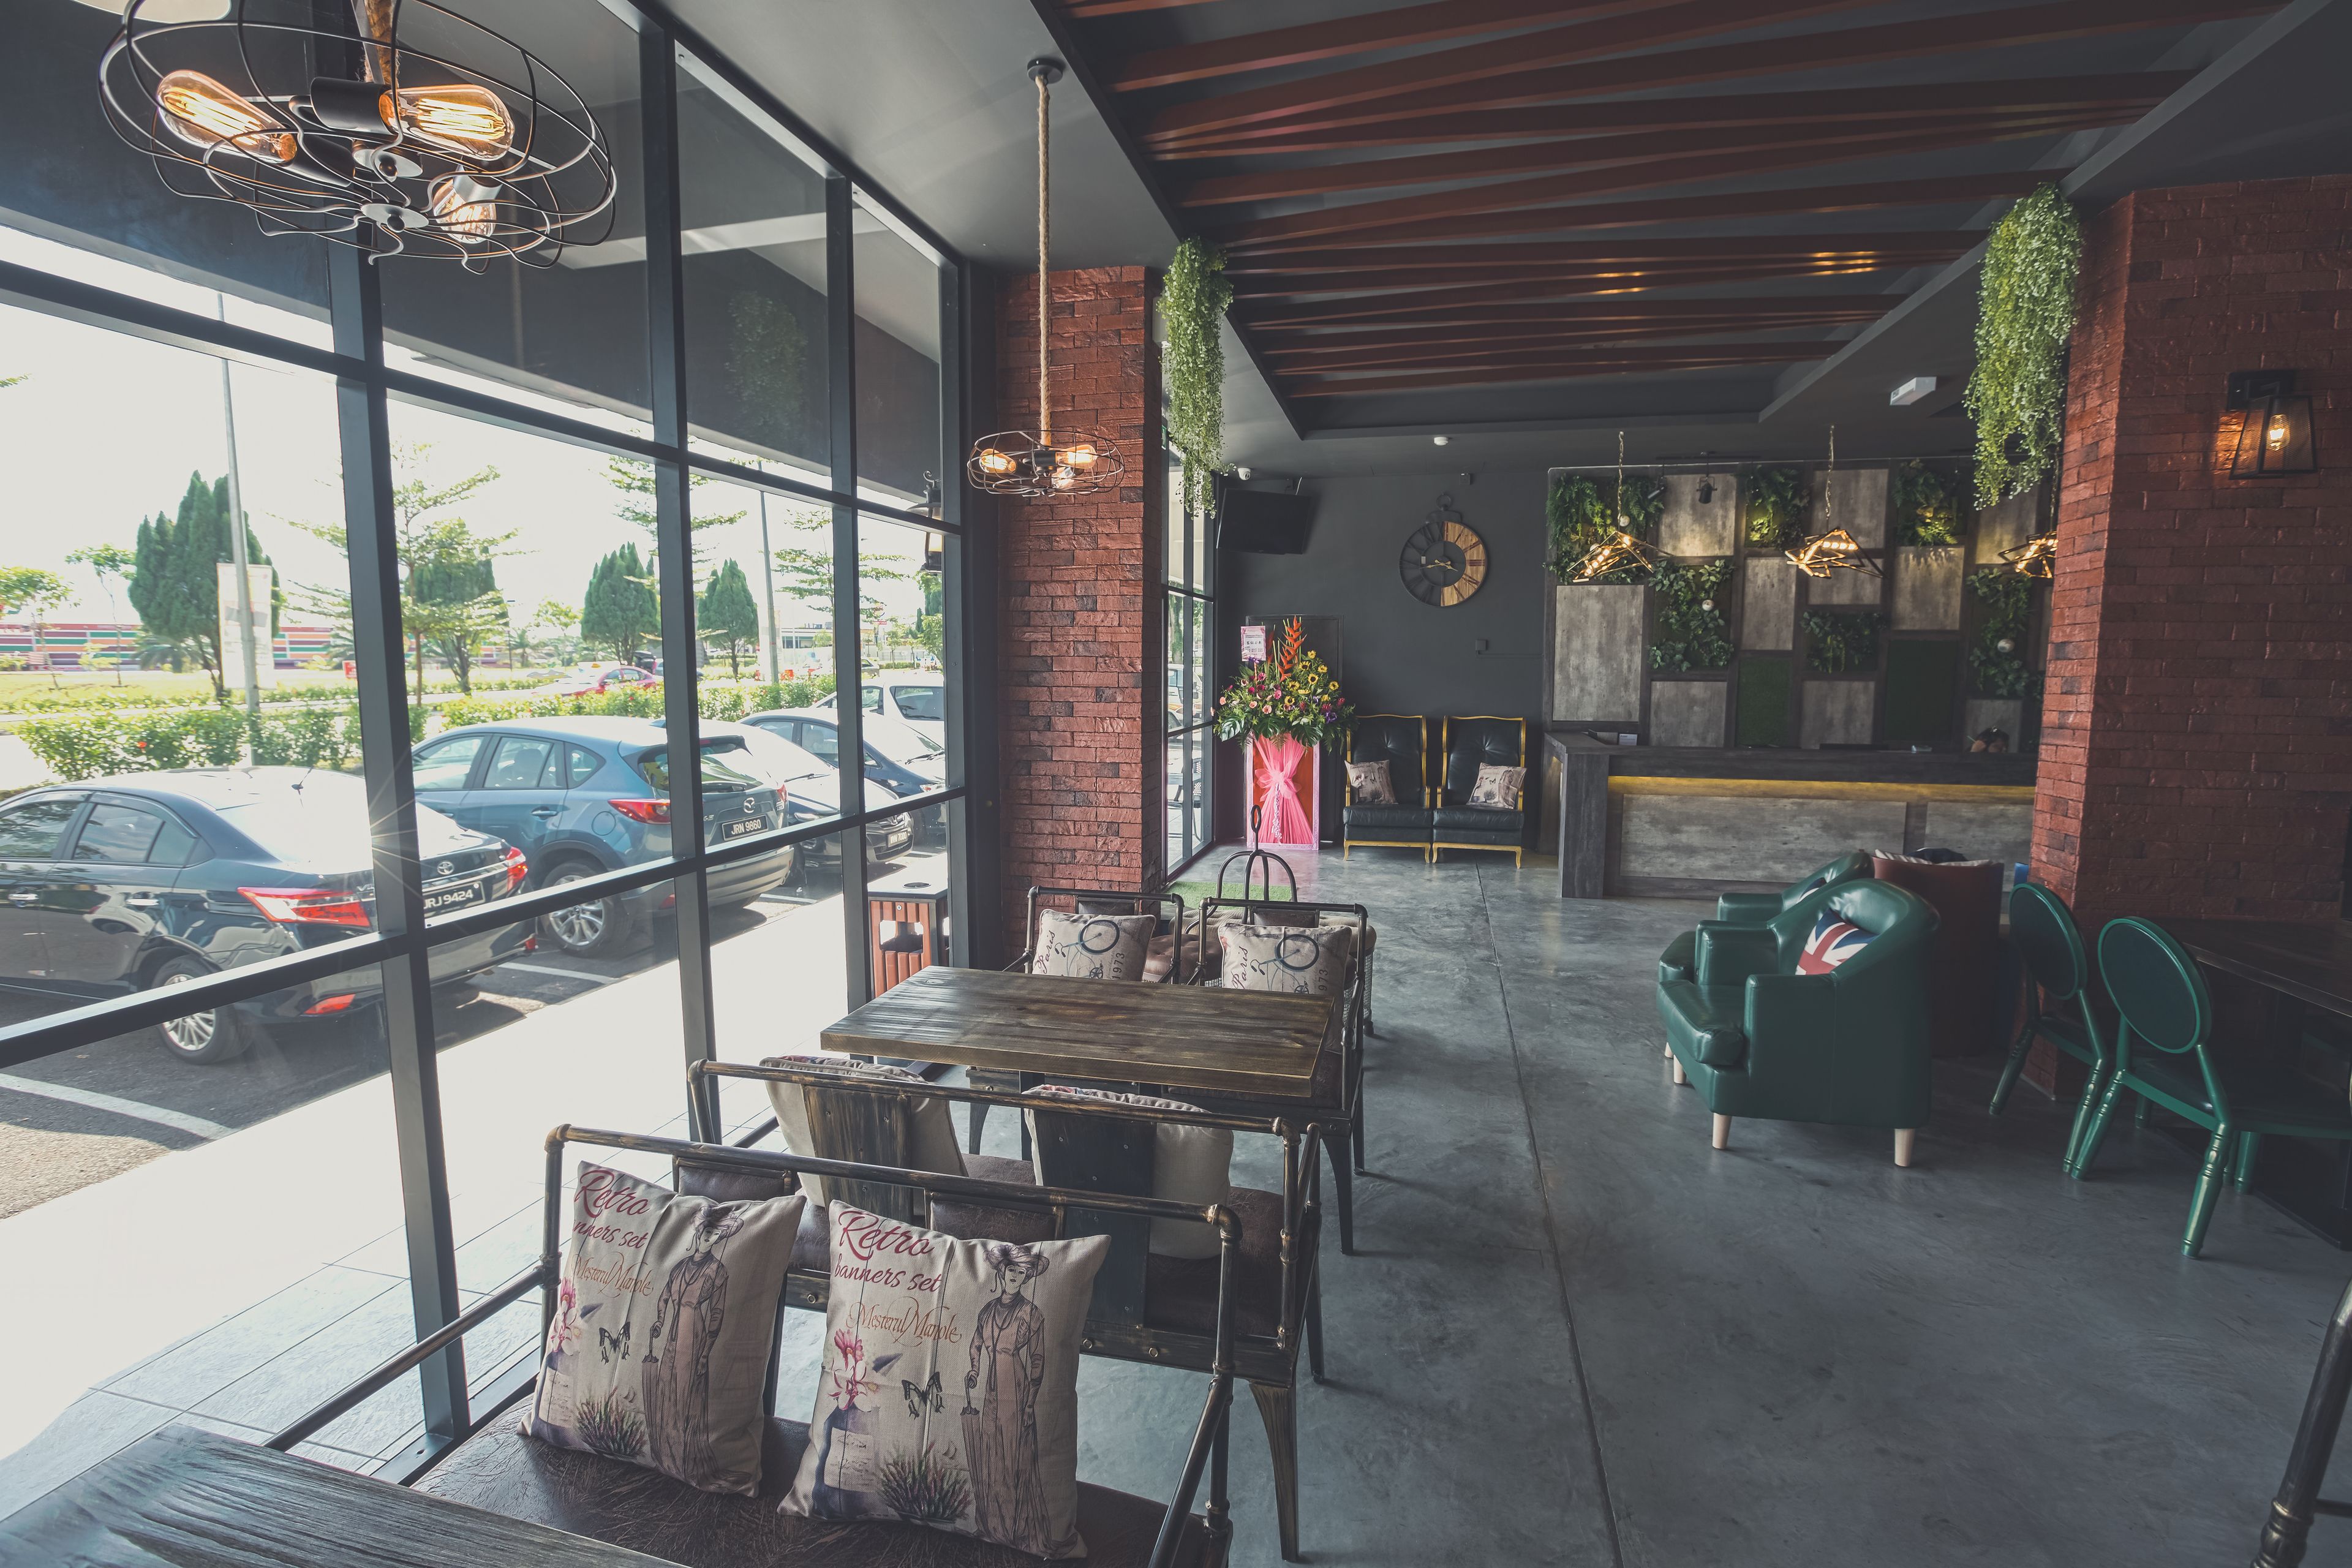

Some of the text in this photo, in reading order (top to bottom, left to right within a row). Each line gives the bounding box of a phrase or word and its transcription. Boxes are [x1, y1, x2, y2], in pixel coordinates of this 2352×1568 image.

[731, 818, 762, 835] JRN 9860
[424, 889, 473, 909] JRJ 9424
[1035, 930, 1055, 974] Paris
[1112, 952, 1125, 979] 1973
[1231, 946, 1248, 989] Paris
[1318, 969, 1329, 992] 973
[575, 1170, 650, 1218] Retro
[571, 1222, 649, 1249] nners set
[838, 1210, 935, 1261] Retro
[834, 1253, 942, 1292] banners set
